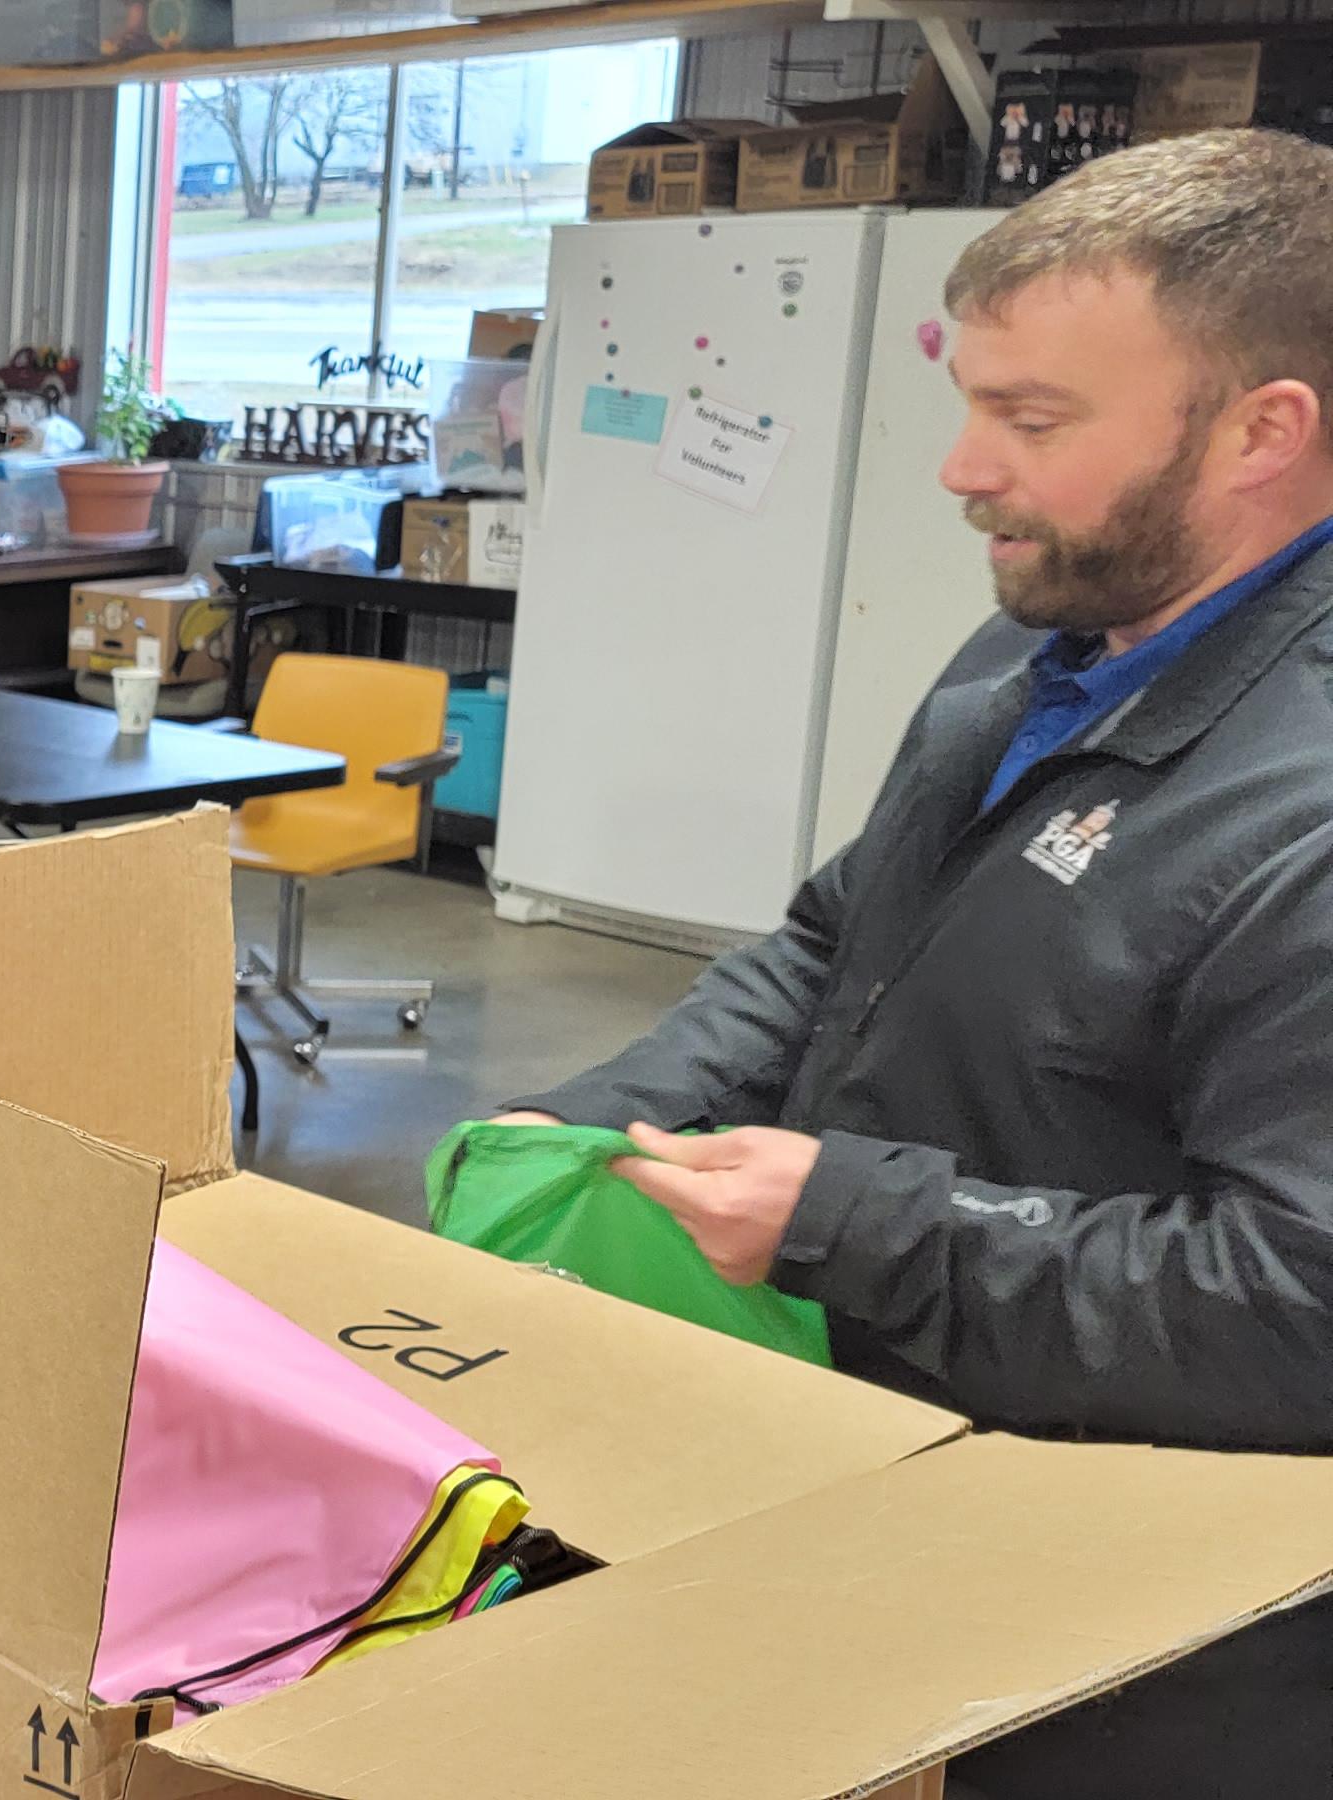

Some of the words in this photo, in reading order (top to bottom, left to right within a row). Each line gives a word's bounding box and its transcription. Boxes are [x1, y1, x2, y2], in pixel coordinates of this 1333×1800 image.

[239, 406, 429, 465] HARVES
[1034, 821, 1094, 870] PGA
[338, 1309, 509, 1381] P2
